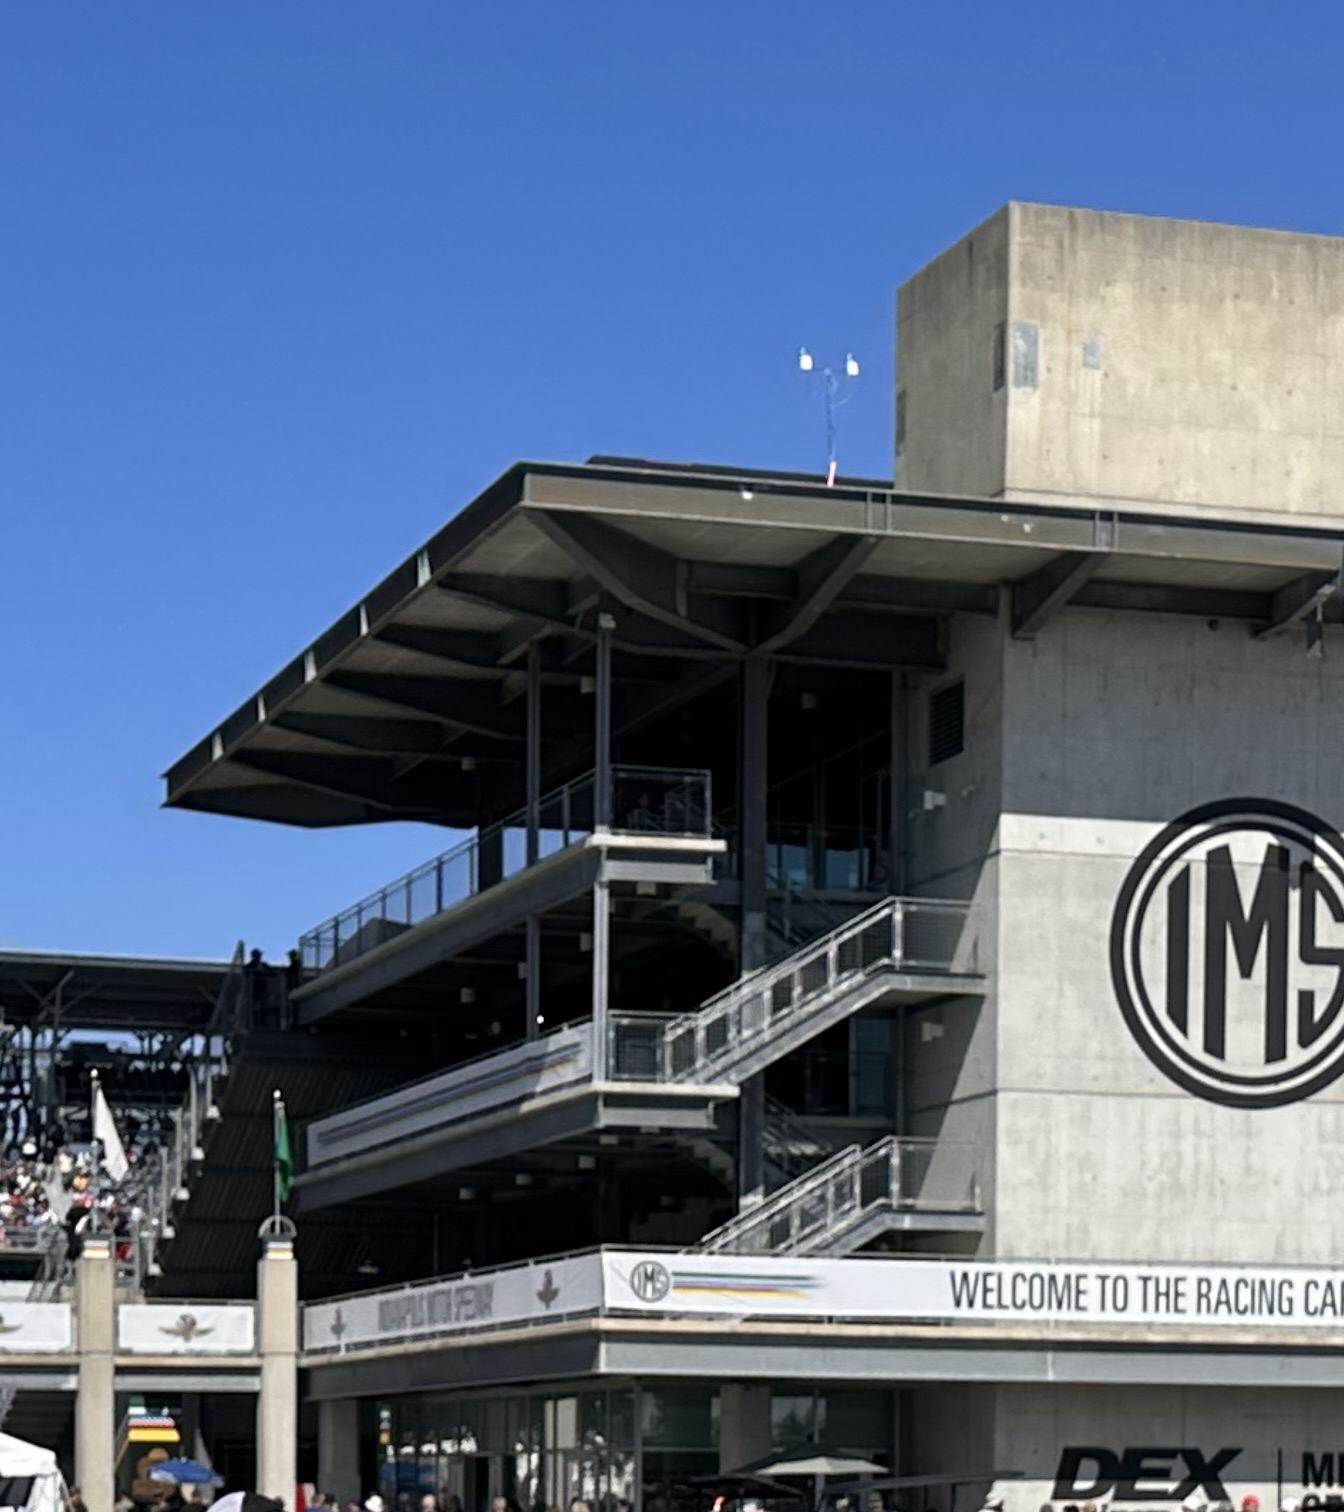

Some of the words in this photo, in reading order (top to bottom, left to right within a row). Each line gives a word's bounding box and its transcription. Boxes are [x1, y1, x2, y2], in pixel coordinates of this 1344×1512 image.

[635, 1262, 668, 1299] IMS
[949, 1269, 1088, 1311] WELCOME
[1094, 1273, 1129, 1313] TO
[1137, 1274, 1187, 1314] THE
[1196, 1276, 1294, 1317] RACING
[1050, 1448, 1244, 1502] DEX
